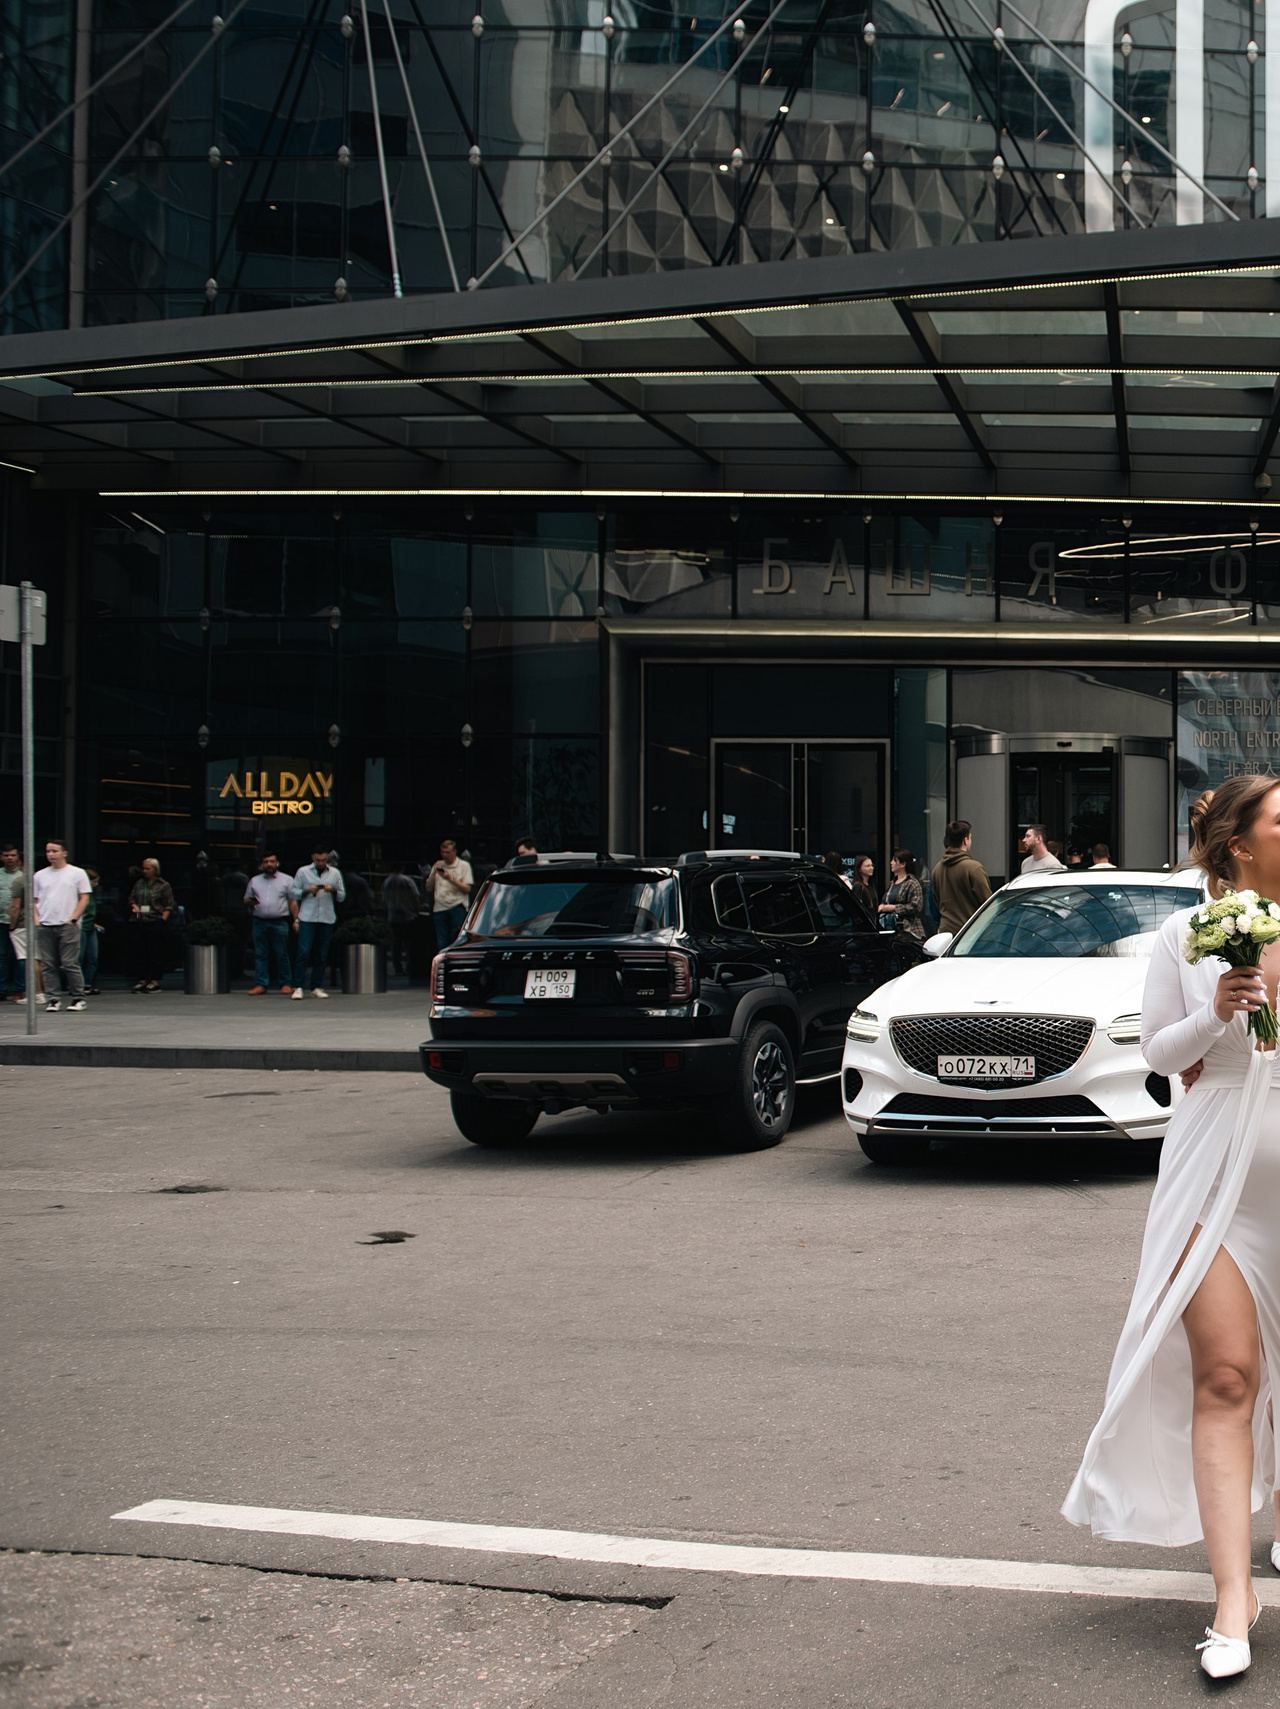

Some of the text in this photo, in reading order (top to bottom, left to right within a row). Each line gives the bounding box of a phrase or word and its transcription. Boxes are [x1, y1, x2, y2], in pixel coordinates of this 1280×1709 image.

[761, 537, 1056, 597] БАШНЯ
[1193, 730, 1238, 748] NORTH
[218, 770, 334, 798] ALL DAY
[251, 800, 315, 816] BISTRO
[501, 951, 595, 961] HAVAL
[546, 971, 568, 983] 009
[553, 985, 570, 994] 150
[1013, 1057, 1029, 1070] 71
